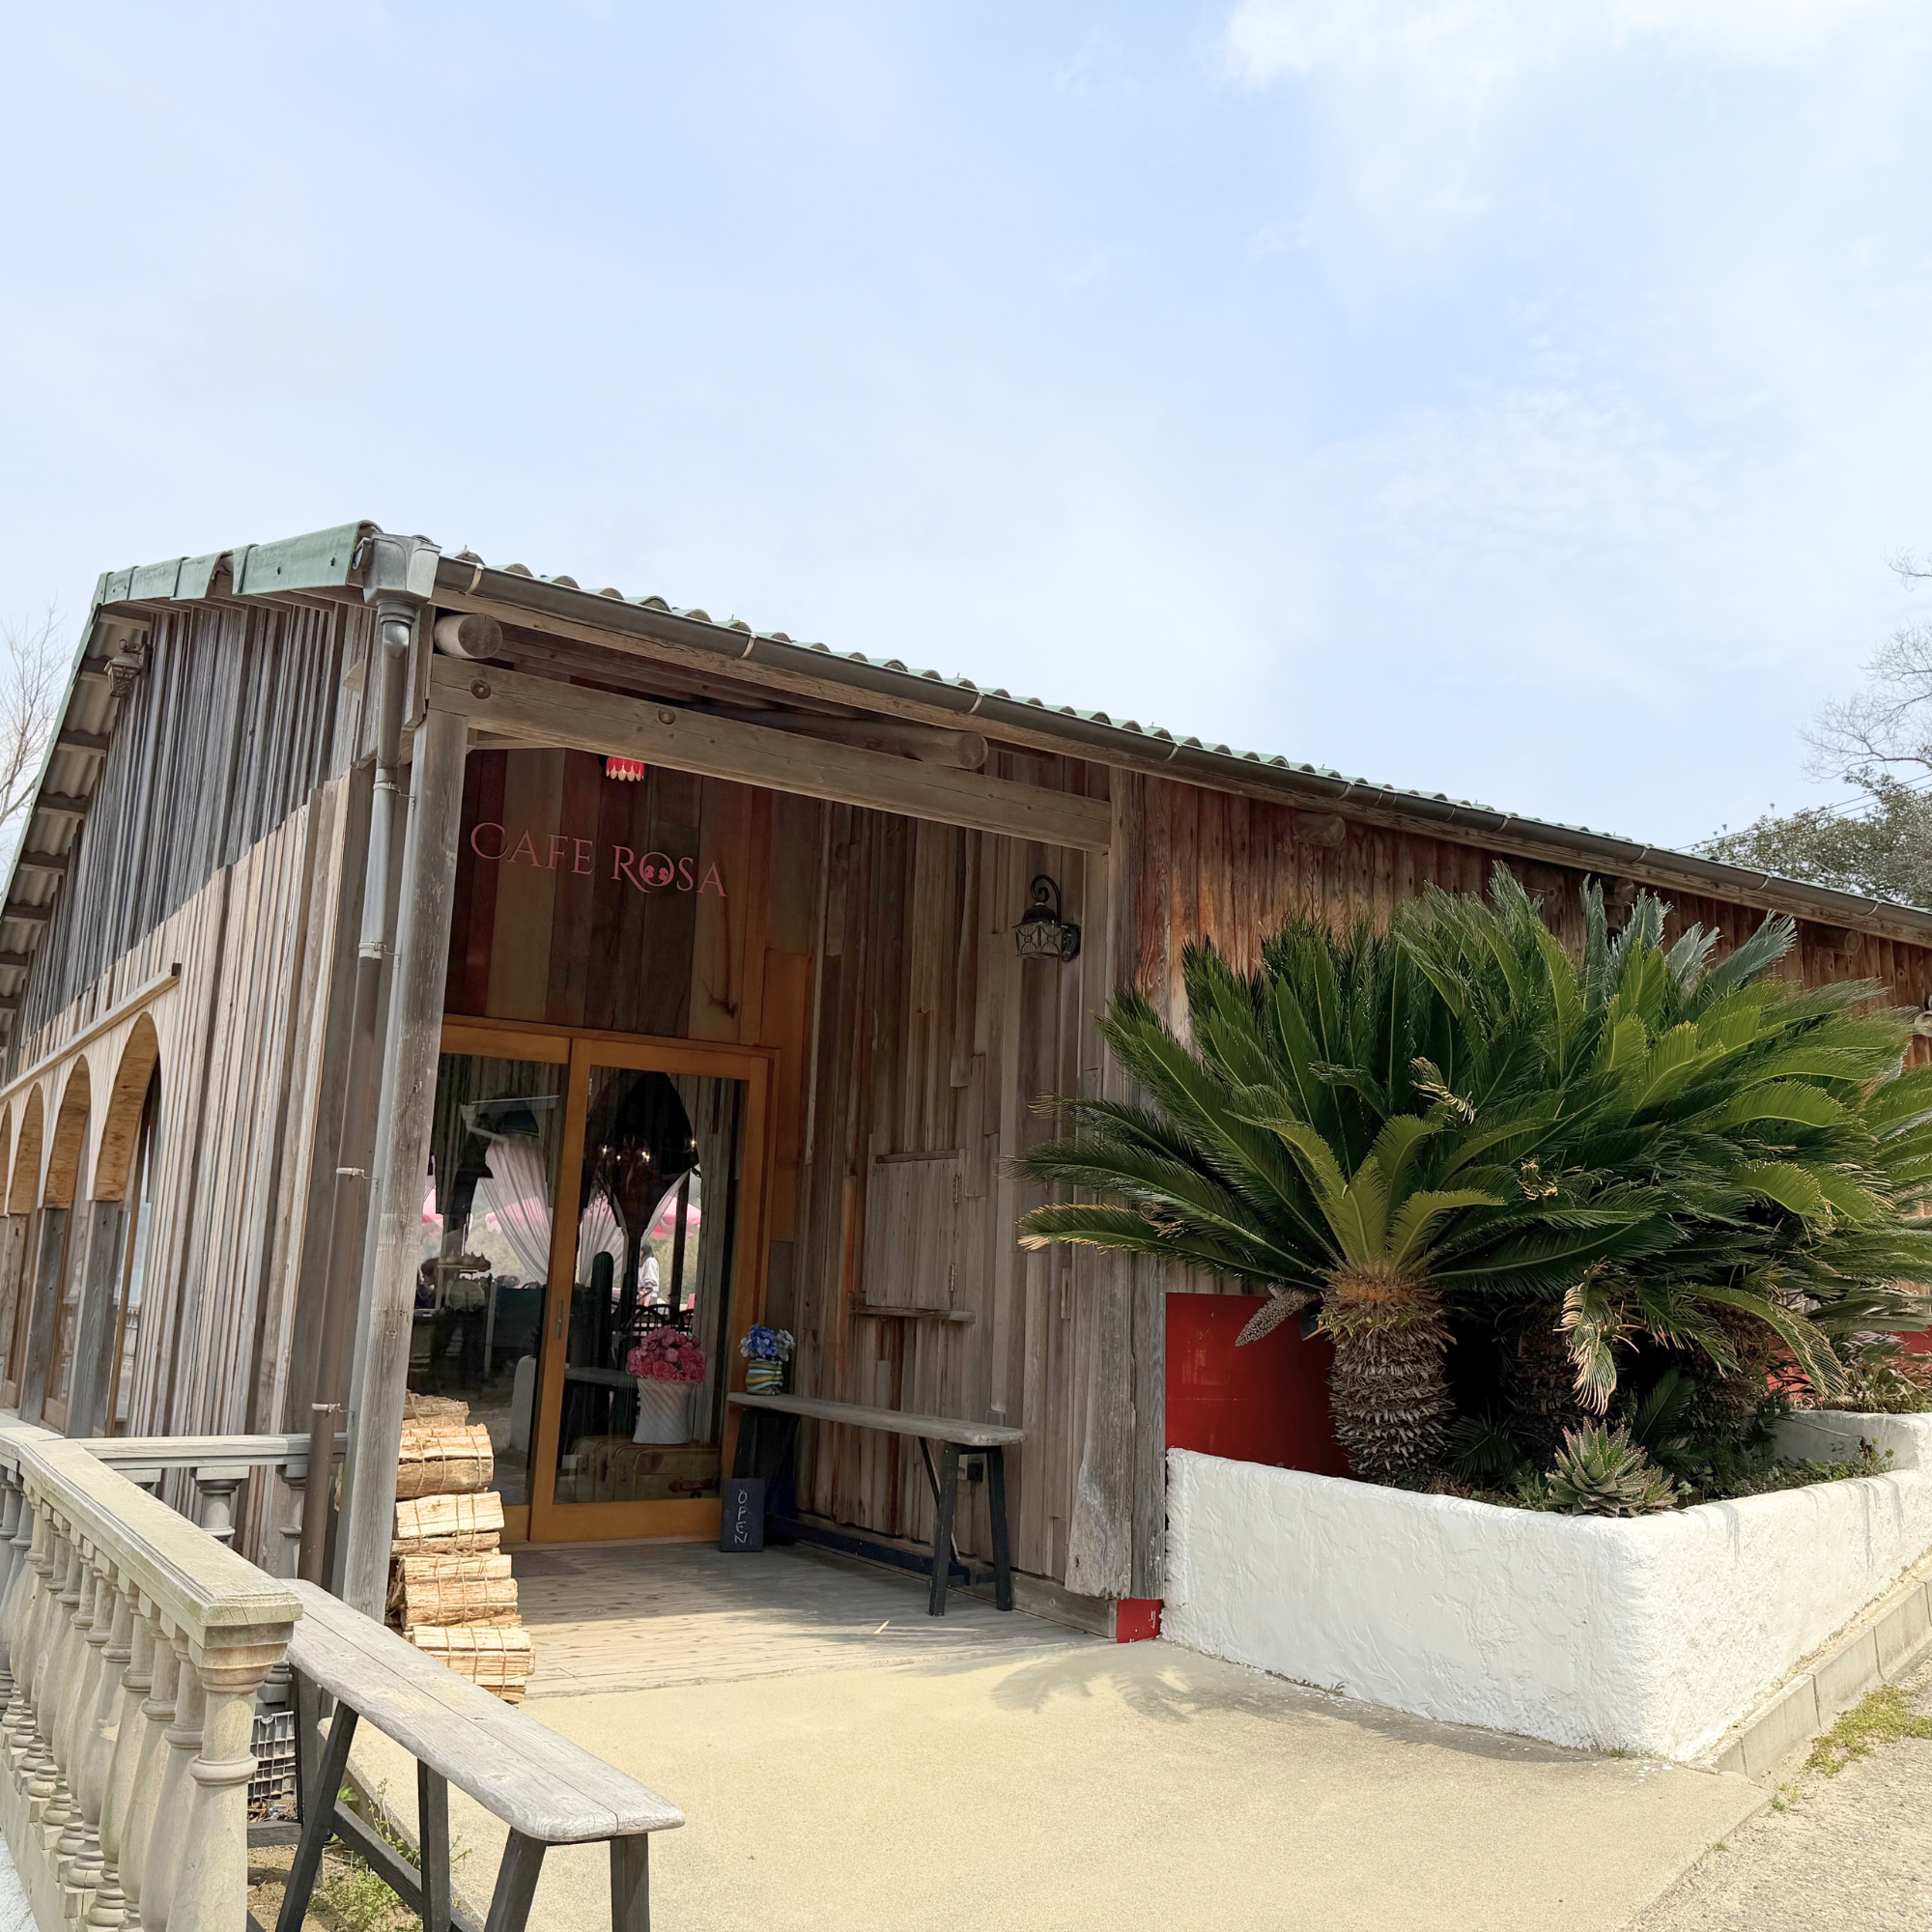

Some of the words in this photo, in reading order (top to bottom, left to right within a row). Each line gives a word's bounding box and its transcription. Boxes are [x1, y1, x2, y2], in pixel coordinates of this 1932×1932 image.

[470, 822, 594, 875] CAFE
[610, 844, 727, 897] ROSA
[734, 1491, 749, 1545] OPEN
